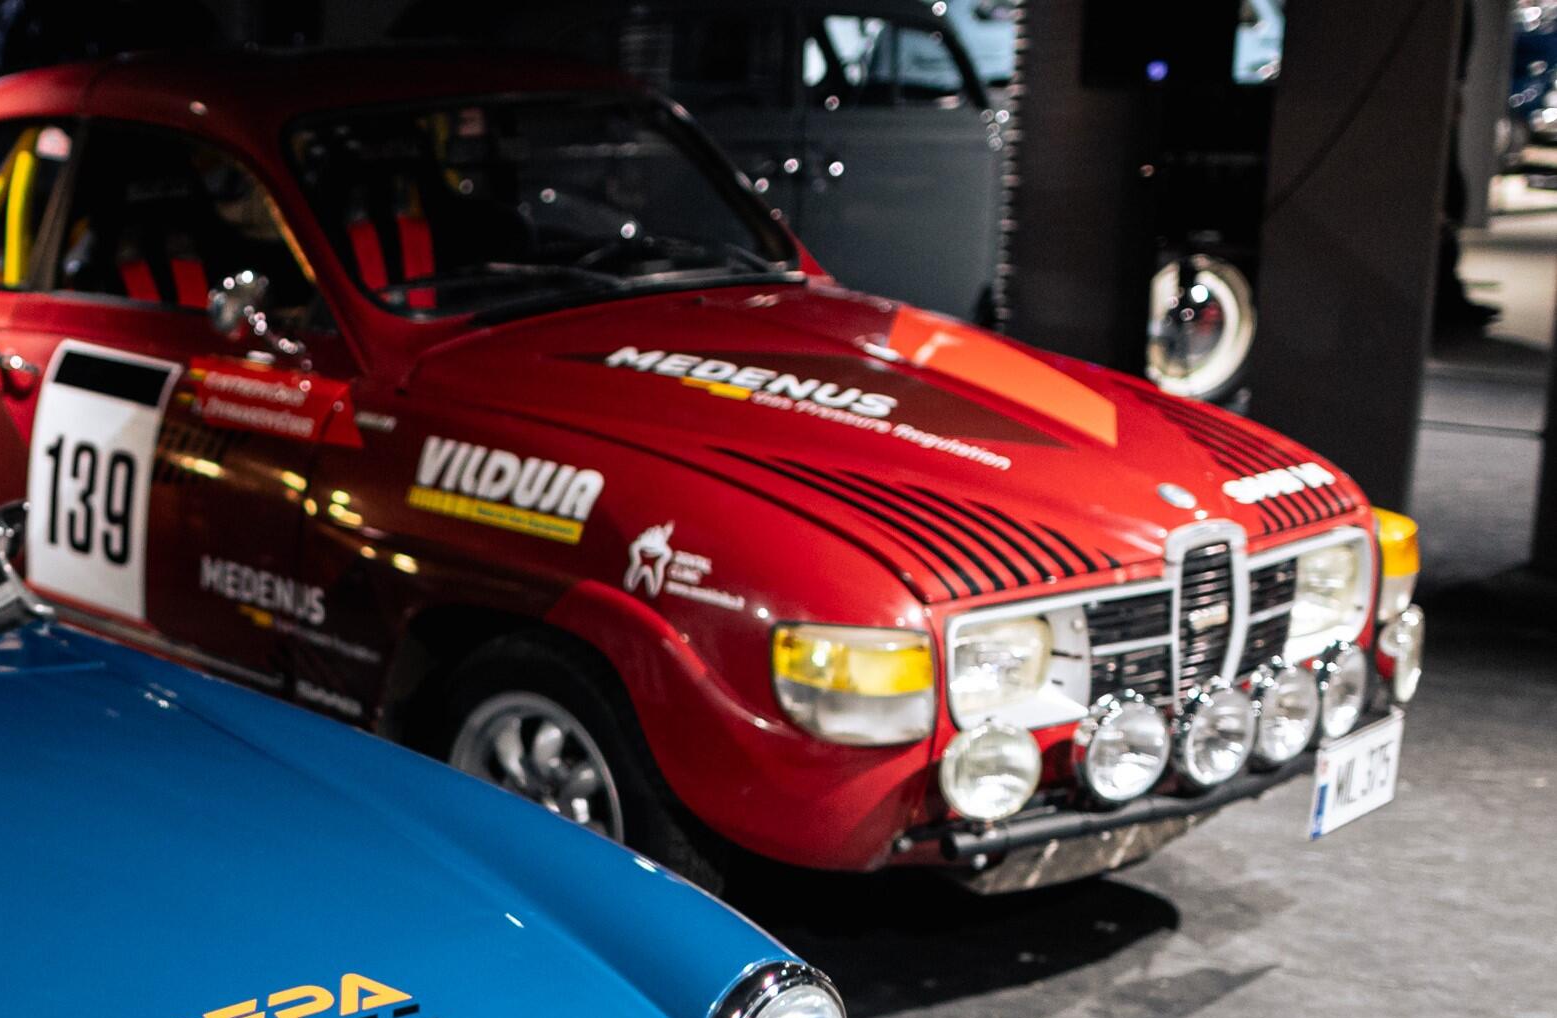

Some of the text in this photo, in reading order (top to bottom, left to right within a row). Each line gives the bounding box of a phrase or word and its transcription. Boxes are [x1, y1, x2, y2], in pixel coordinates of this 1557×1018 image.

[605, 345, 899, 417] MEDENUS
[416, 435, 605, 521] VILDUJA
[893, 423, 1012, 471] Regulation
[46, 434, 138, 566] 139
[199, 553, 328, 625] MEDENUS
